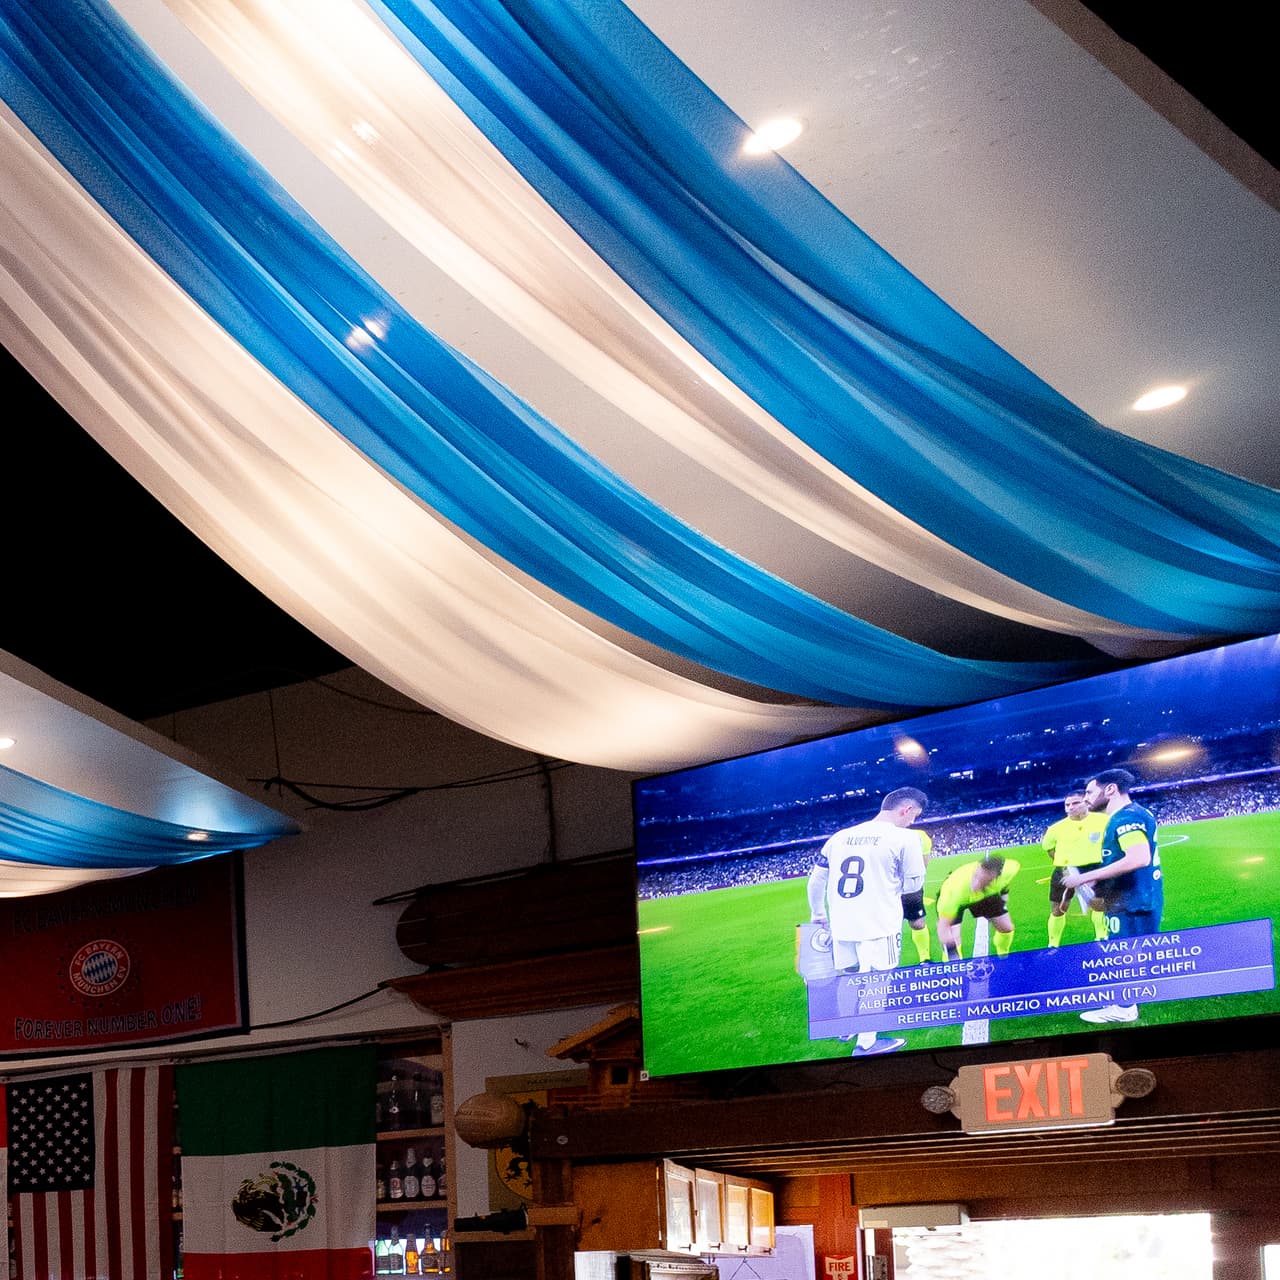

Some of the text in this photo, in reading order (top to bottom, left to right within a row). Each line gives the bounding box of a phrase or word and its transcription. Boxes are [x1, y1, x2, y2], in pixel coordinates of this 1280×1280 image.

[838, 855, 864, 899] 8
[1101, 941, 1128, 953] VAR
[1142, 934, 1181, 948] AVAR
[1082, 945, 1202, 969] MARCO DI BELLO
[847, 962, 974, 986] ASSISTANT REFEREES
[1088, 960, 1197, 982] DANIELE CHIFFI
[857, 976, 963, 998] DANIELE BINDONI
[859, 989, 963, 1010] ALBERTO TEGONI
[897, 984, 1158, 1024] REFEREE: MAURIZIO MARIANI (ITA)
[14, 1016, 84, 1041] FOREVER
[87, 1009, 159, 1036] NUMBER
[982, 1057, 1089, 1122] EXIT
[828, 1261, 851, 1272] FIRE
